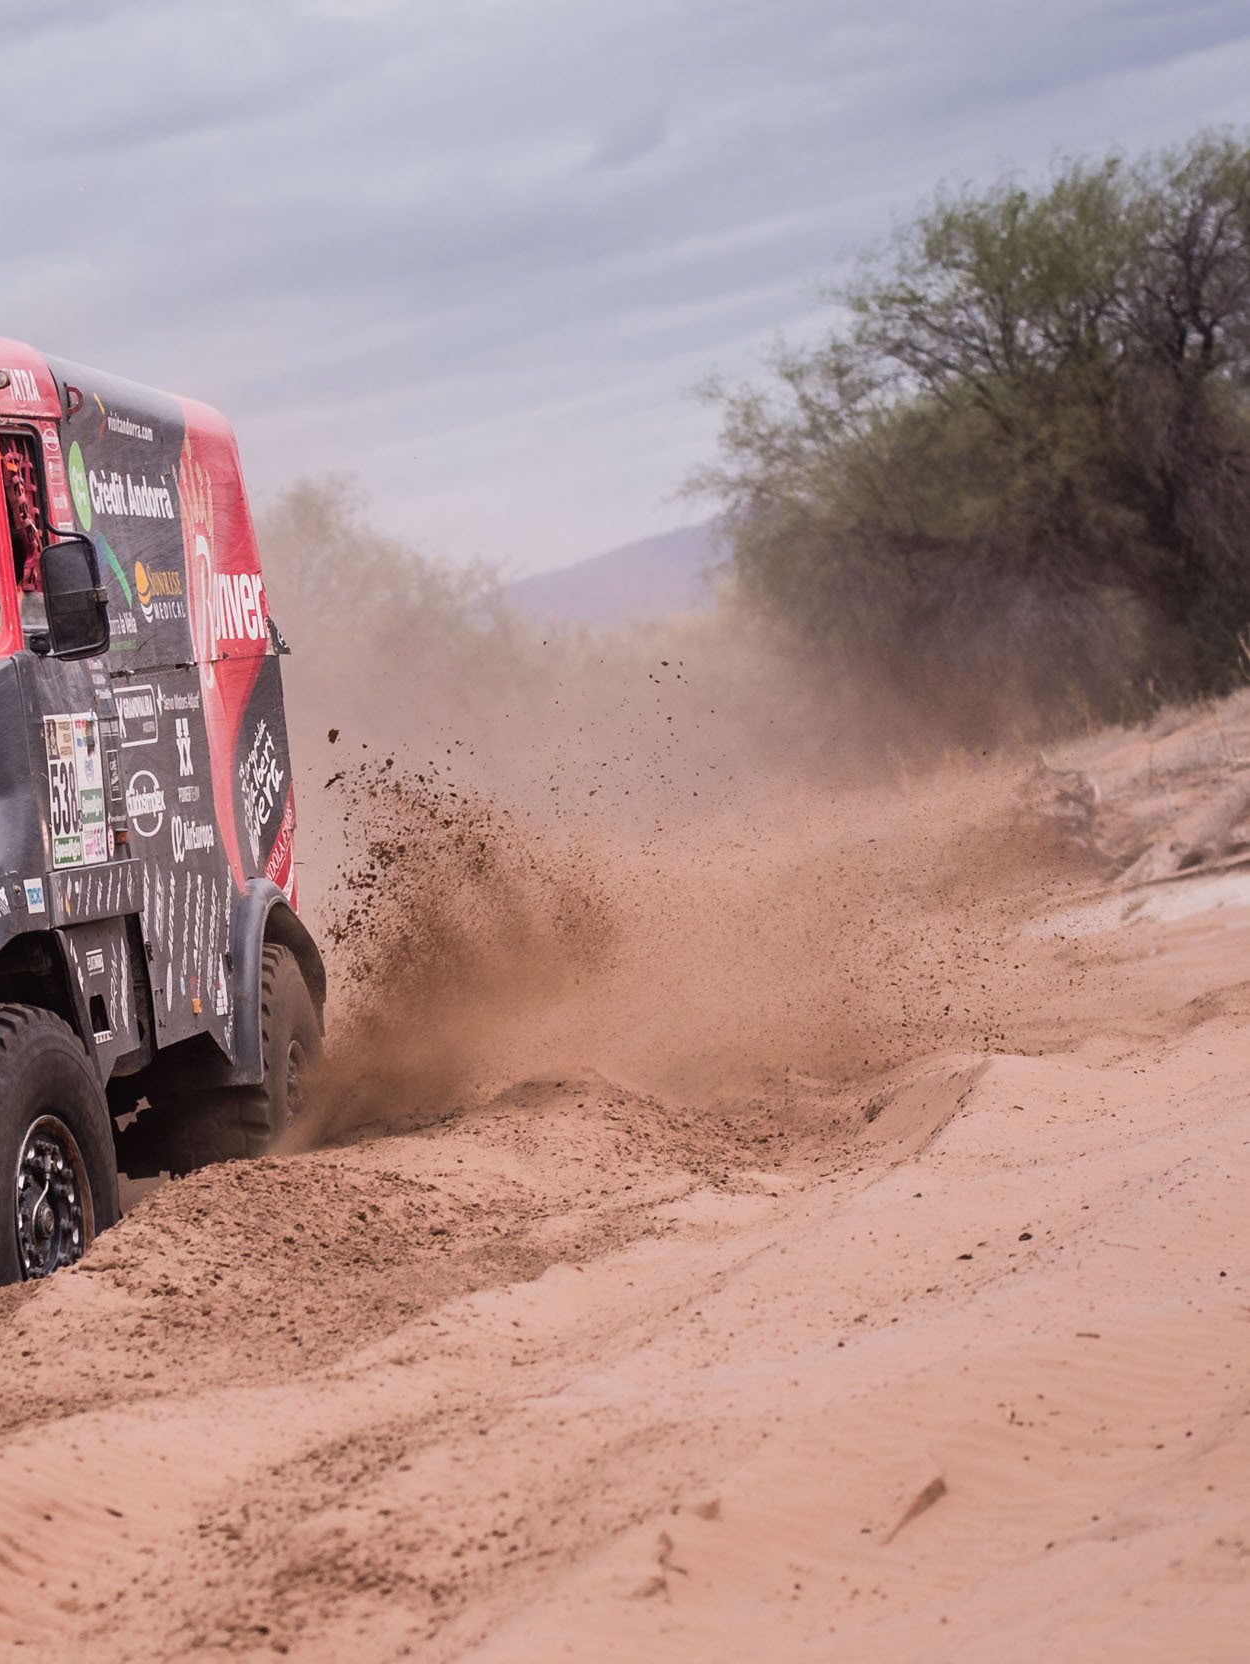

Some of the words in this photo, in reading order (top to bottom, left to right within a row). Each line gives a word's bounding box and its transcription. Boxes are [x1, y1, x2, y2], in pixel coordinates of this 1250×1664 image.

[107, 410, 154, 442] visitandorra.com
[88, 469, 129, 516] Crèdit
[126, 473, 175, 520] Andorrà
[153, 600, 187, 620] MEDICAL
[50, 760, 79, 836] 538
